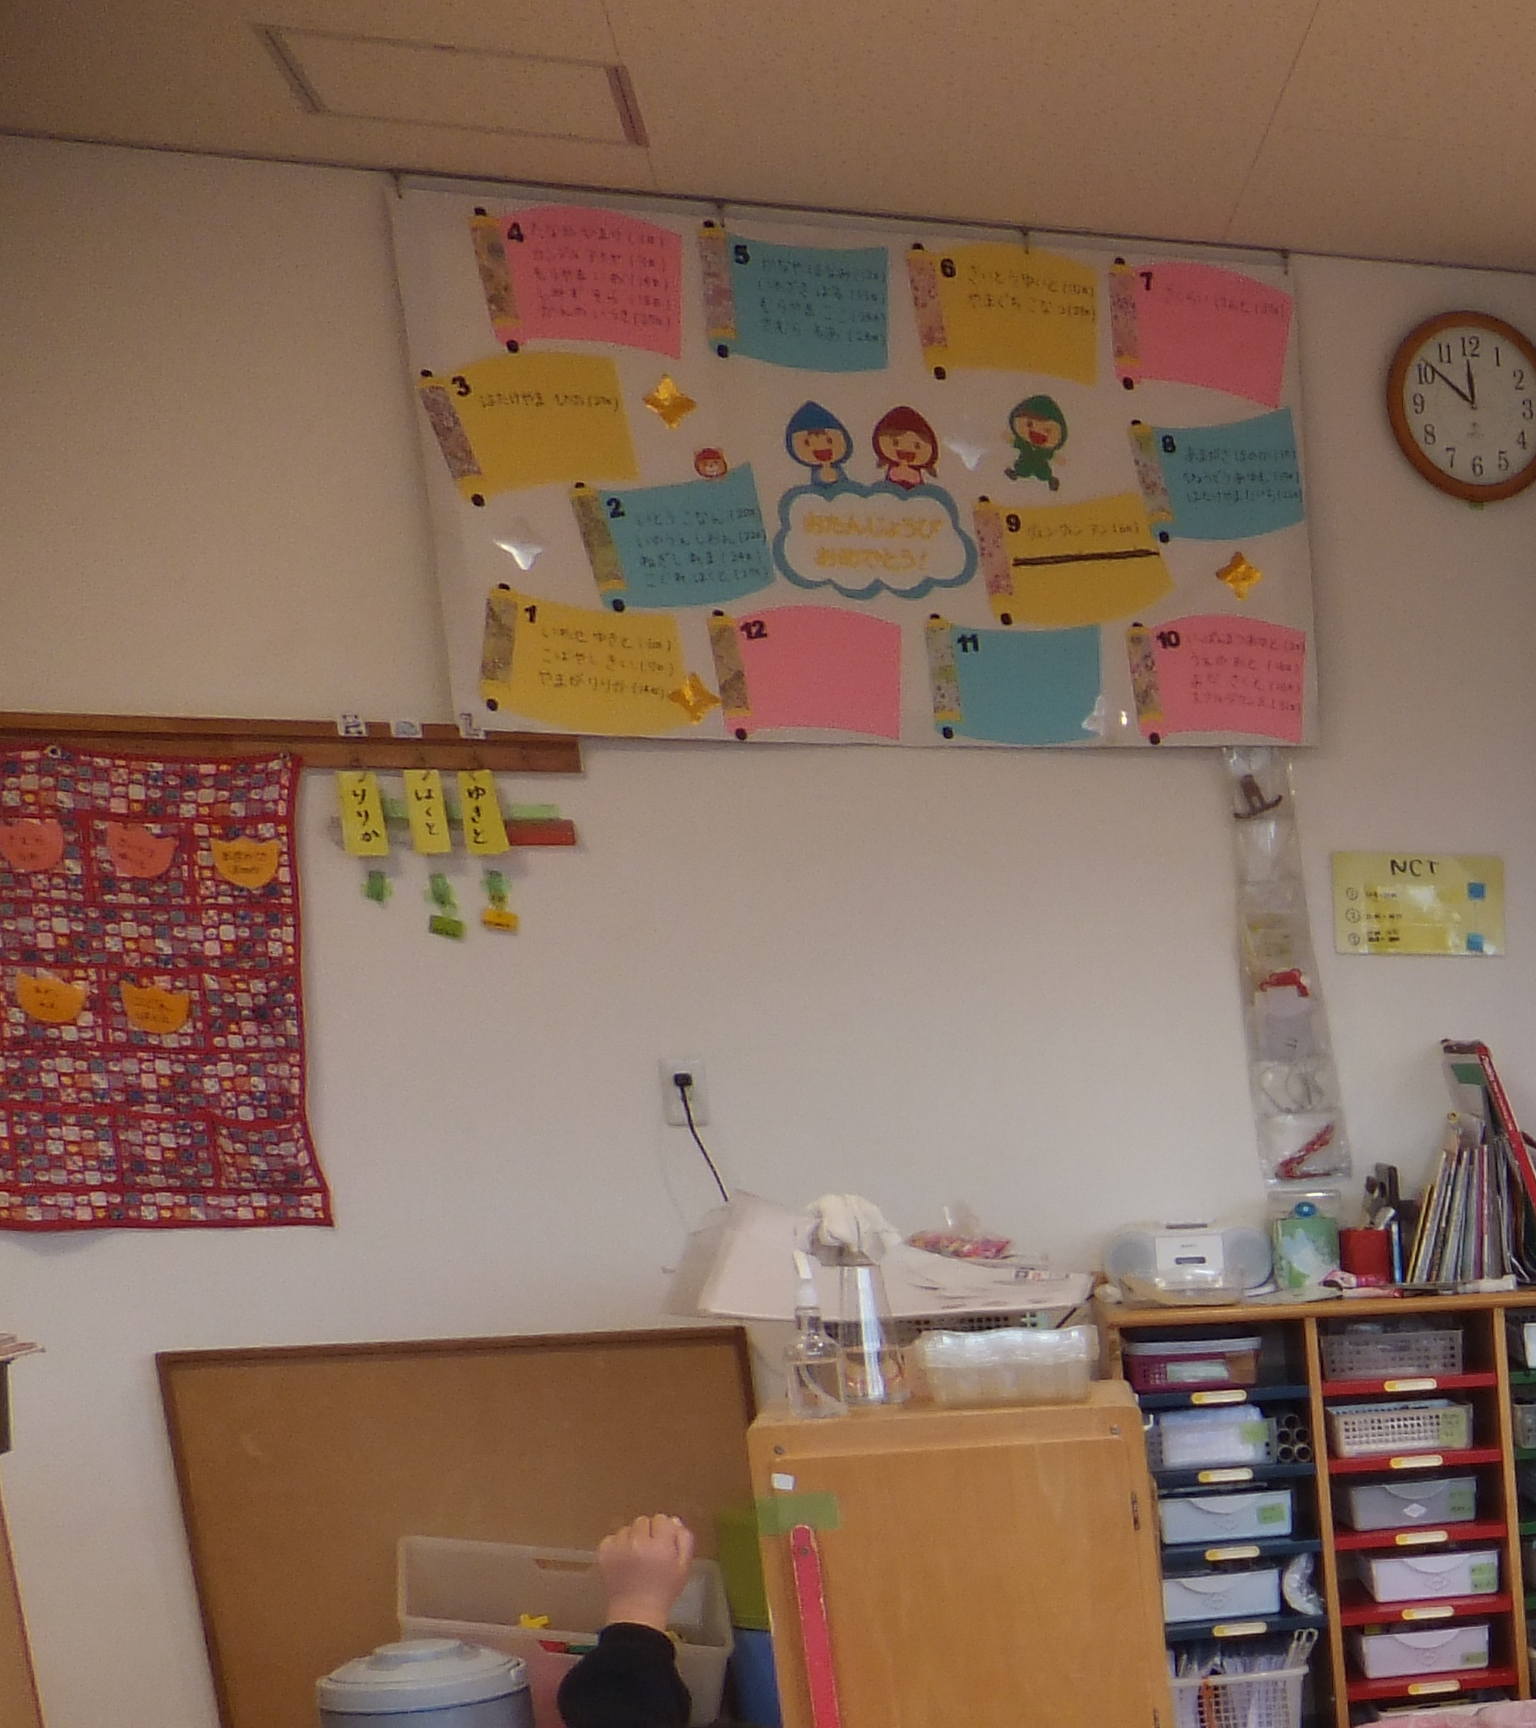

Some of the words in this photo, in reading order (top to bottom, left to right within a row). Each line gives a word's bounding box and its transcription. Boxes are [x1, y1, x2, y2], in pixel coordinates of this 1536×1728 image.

[508, 222, 524, 242] 4
[734, 245, 750, 265] 5
[941, 258, 956, 278] 6
[1139, 271, 1153, 291] 7
[1438, 343, 1452, 364] 11
[1461, 336, 1480, 358] 12
[1494, 347, 1501, 367] 1
[1417, 363, 1436, 385] 10
[1513, 369, 1525, 391] 2
[452, 375, 471, 397] 3
[1412, 393, 1425, 415] 9
[1522, 399, 1533, 421] 3
[1162, 434, 1177, 453] 8
[1423, 424, 1436, 445] 8
[1516, 431, 1527, 450] 4
[1446, 447, 1457, 469] 7
[1472, 456, 1484, 477] 6
[1498, 451, 1509, 471] 5
[606, 497, 625, 518] 2
[1006, 514, 1021, 533] 9
[524, 604, 536, 624] 1
[740, 620, 767, 640] 12
[1157, 630, 1180, 649] 10
[957, 633, 979, 653] 11
[351, 788, 379, 843] りりか
[414, 788, 439, 836] はくと
[1389, 859, 1440, 877] NCT
